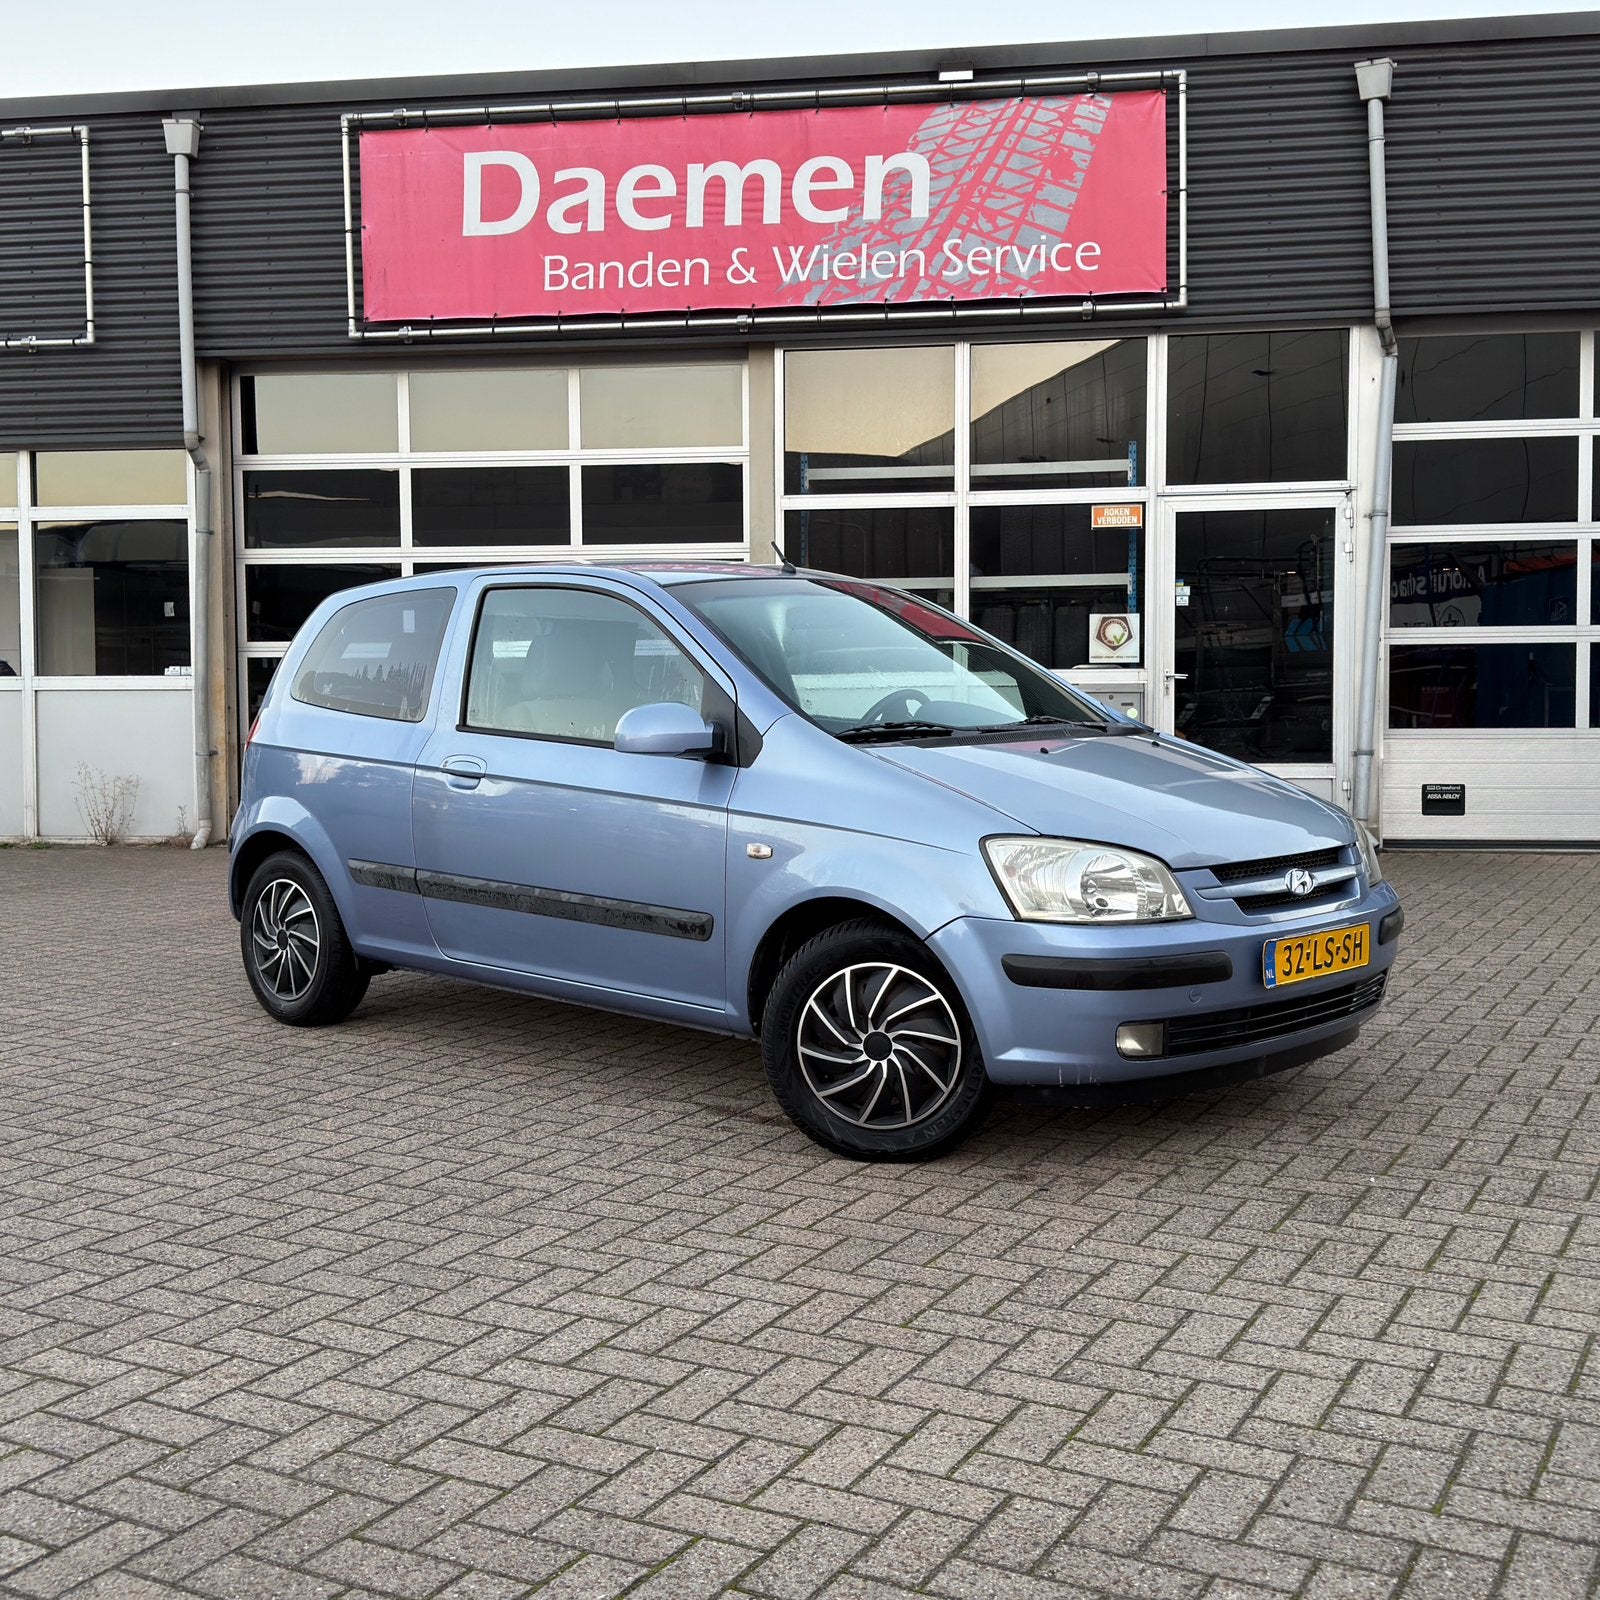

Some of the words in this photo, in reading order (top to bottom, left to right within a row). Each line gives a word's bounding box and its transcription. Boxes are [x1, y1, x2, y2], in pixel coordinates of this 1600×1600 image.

[462, 150, 931, 237] Daemen
[544, 251, 710, 291] Banden
[726, 247, 758, 285] &
[772, 243, 925, 282] Wielen
[942, 235, 1101, 276] Service
[1097, 515, 1138, 525] VERBODEN
[1104, 507, 1130, 516] ROKEN
[1282, 930, 1363, 977] 32-LS-SH
[1265, 969, 1275, 979] NL
